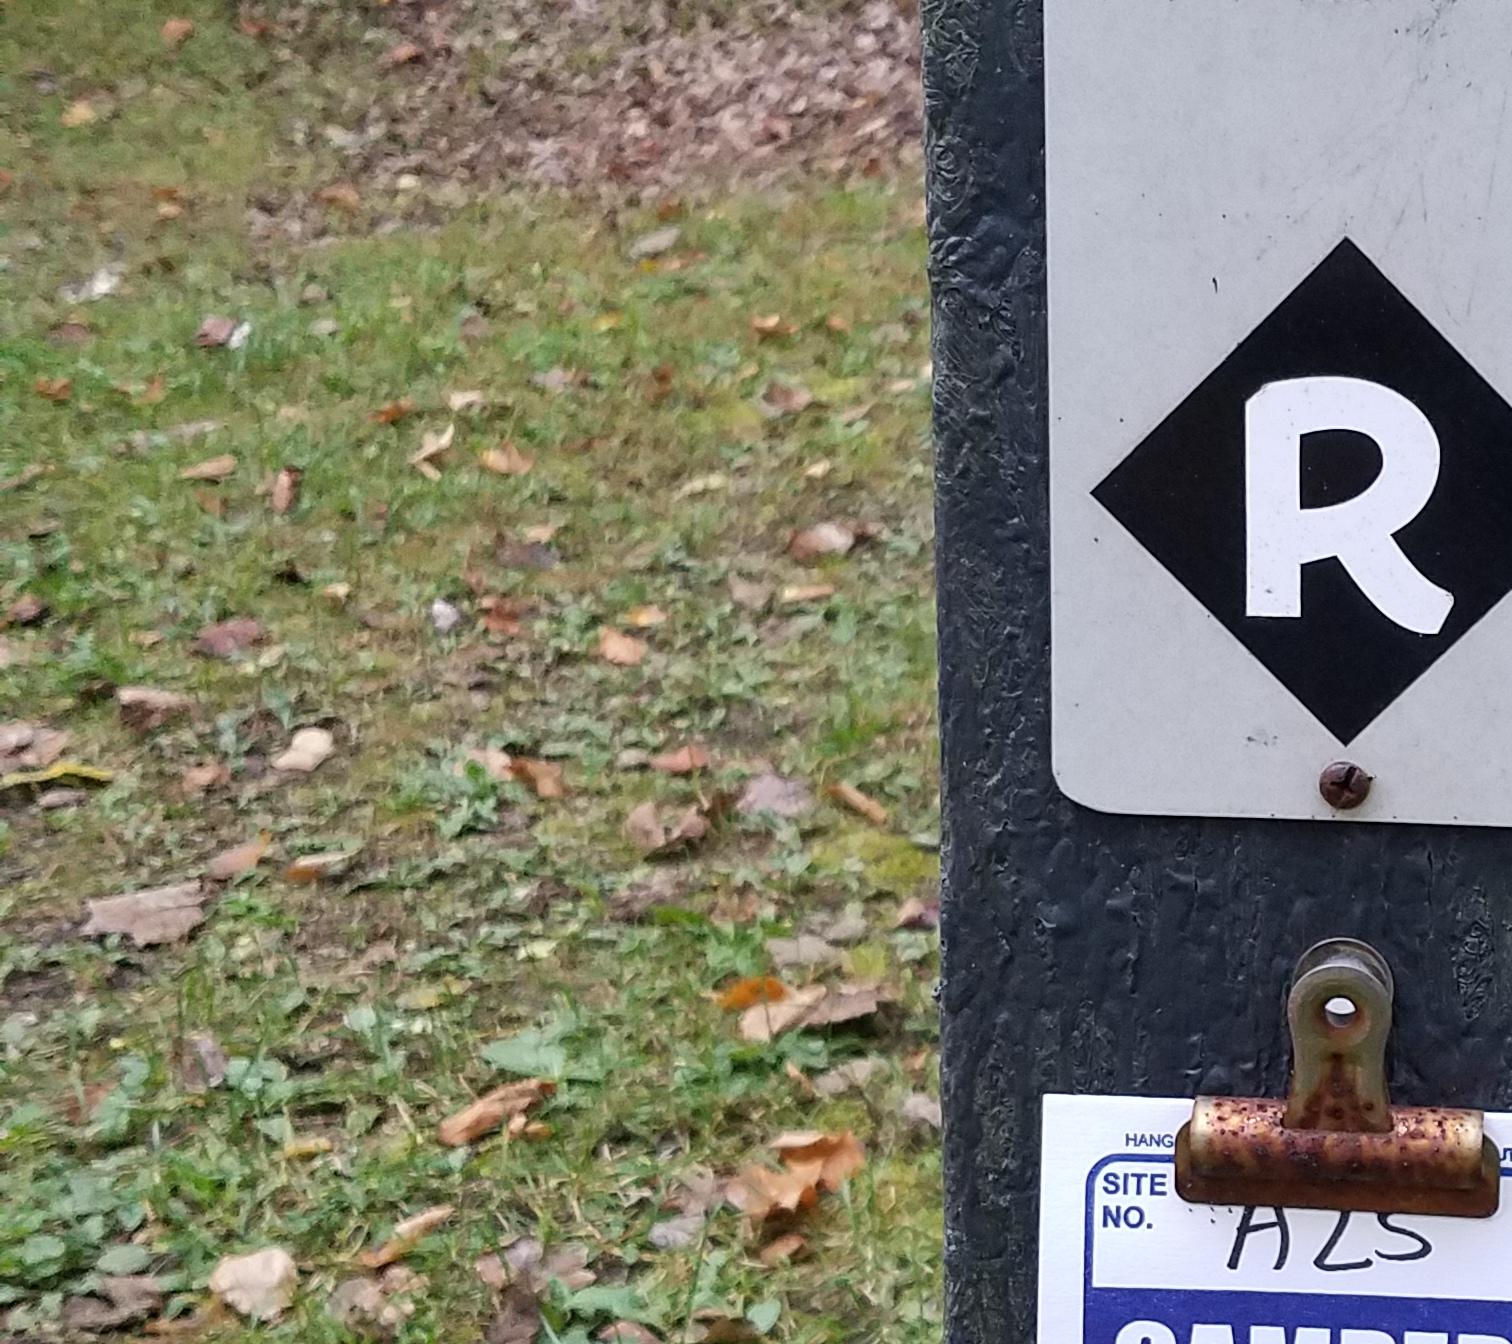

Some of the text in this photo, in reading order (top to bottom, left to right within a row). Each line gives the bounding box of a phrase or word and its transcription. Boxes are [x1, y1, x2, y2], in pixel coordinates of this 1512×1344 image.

[1245, 376, 1454, 634] R
[1125, 1132, 1174, 1149] HANG
[1102, 1172, 1168, 1197] SITE
[1102, 1205, 1153, 1229] NO.
